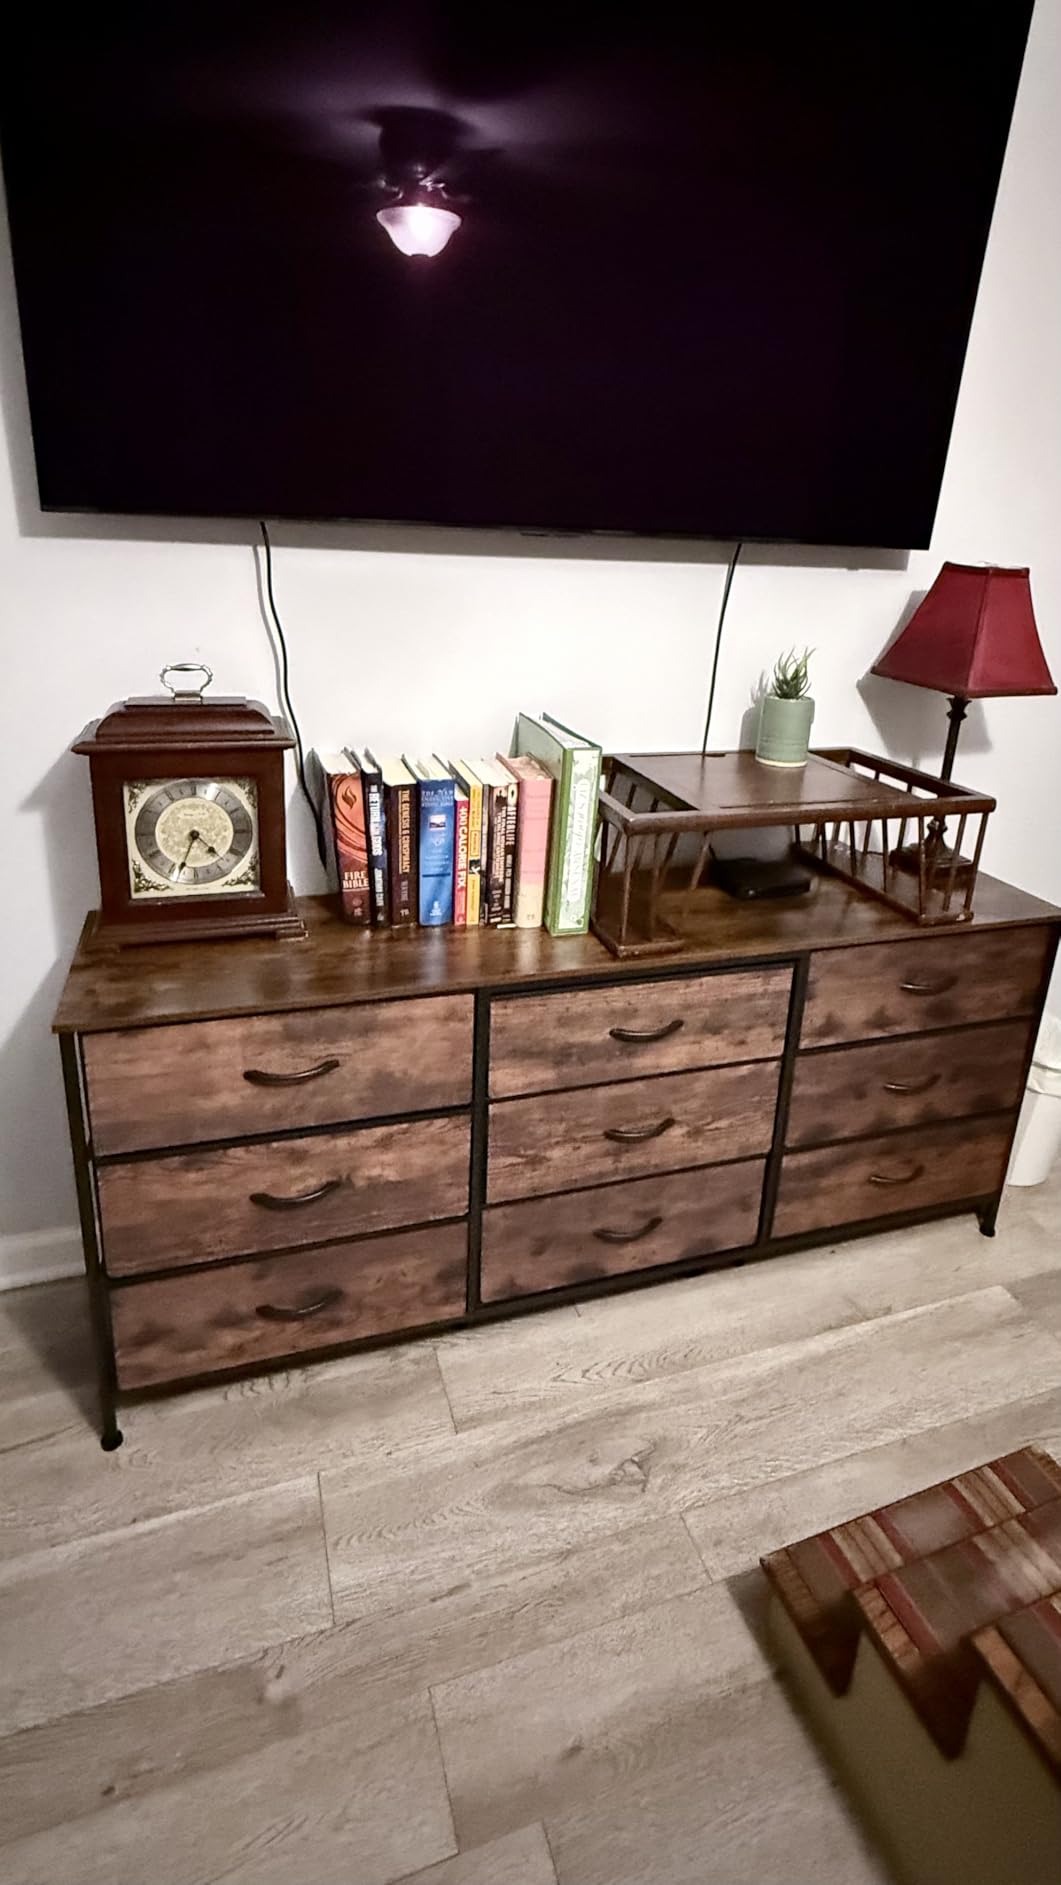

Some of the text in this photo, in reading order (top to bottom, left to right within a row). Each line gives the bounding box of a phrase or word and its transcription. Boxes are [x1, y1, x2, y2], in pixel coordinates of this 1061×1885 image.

[401, 789, 410, 802] THE
[401, 803, 410, 829] GENESIS
[458, 806, 468, 825] 400
[505, 806, 516, 846] AFTERLIFE
[402, 835, 410, 873] CONSPIRACY
[457, 826, 468, 870] CALORIE
[343, 878, 369, 889] BIBLE
[344, 871, 366, 880] FIRE
[457, 871, 467, 888] FIX
